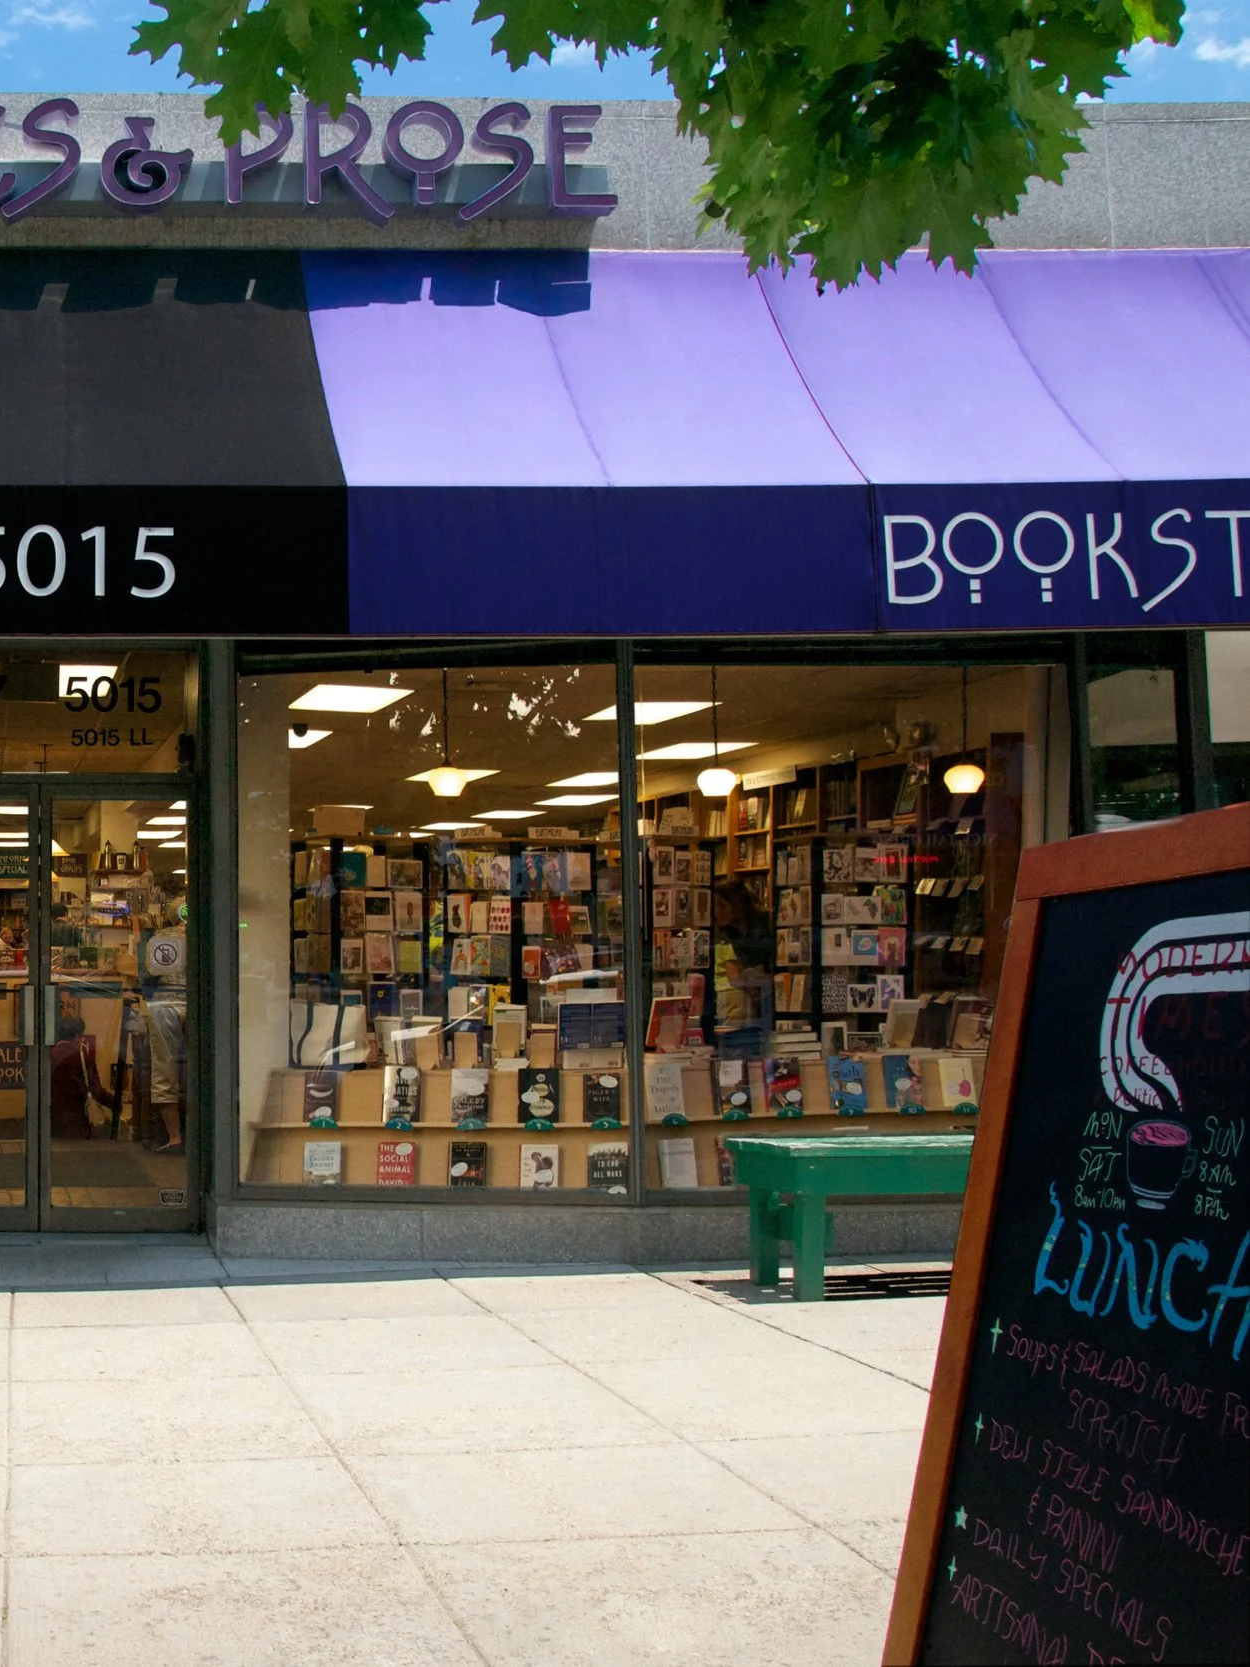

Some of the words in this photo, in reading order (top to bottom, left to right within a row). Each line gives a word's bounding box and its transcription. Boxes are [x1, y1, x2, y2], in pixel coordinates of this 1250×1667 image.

[100, 116, 194, 206] &
[224, 100, 618, 222] PROSE
[883, 507, 1250, 613] BOOKST
[64, 675, 163, 713] 5015
[70, 728, 120, 747] 5015
[129, 728, 154, 746] LL
[535, 828, 563, 838] BIRTHDAY
[379, 1144, 395, 1153] THE
[379, 1154, 410, 1163] SOCIAL
[1078, 1147, 1123, 1182] SAT
[1201, 1115, 1246, 1159] SUN
[379, 1165, 412, 1174] ANIMAL
[1033, 1181, 1250, 1362] LUNCH
[1007, 1324, 1059, 1379] SOUPS
[1072, 1341, 1150, 1394] SALADS
[1151, 1372, 1213, 1419] MADE
[989, 1416, 1033, 1463] DELI
[1038, 1439, 1110, 1502] STYLE
[1067, 1388, 1187, 1479] SCRATCH
[1041, 1493, 1124, 1573] PANINI
[972, 1517, 1049, 1581] DAILY
[1054, 1557, 1174, 1663] SPECIALS
